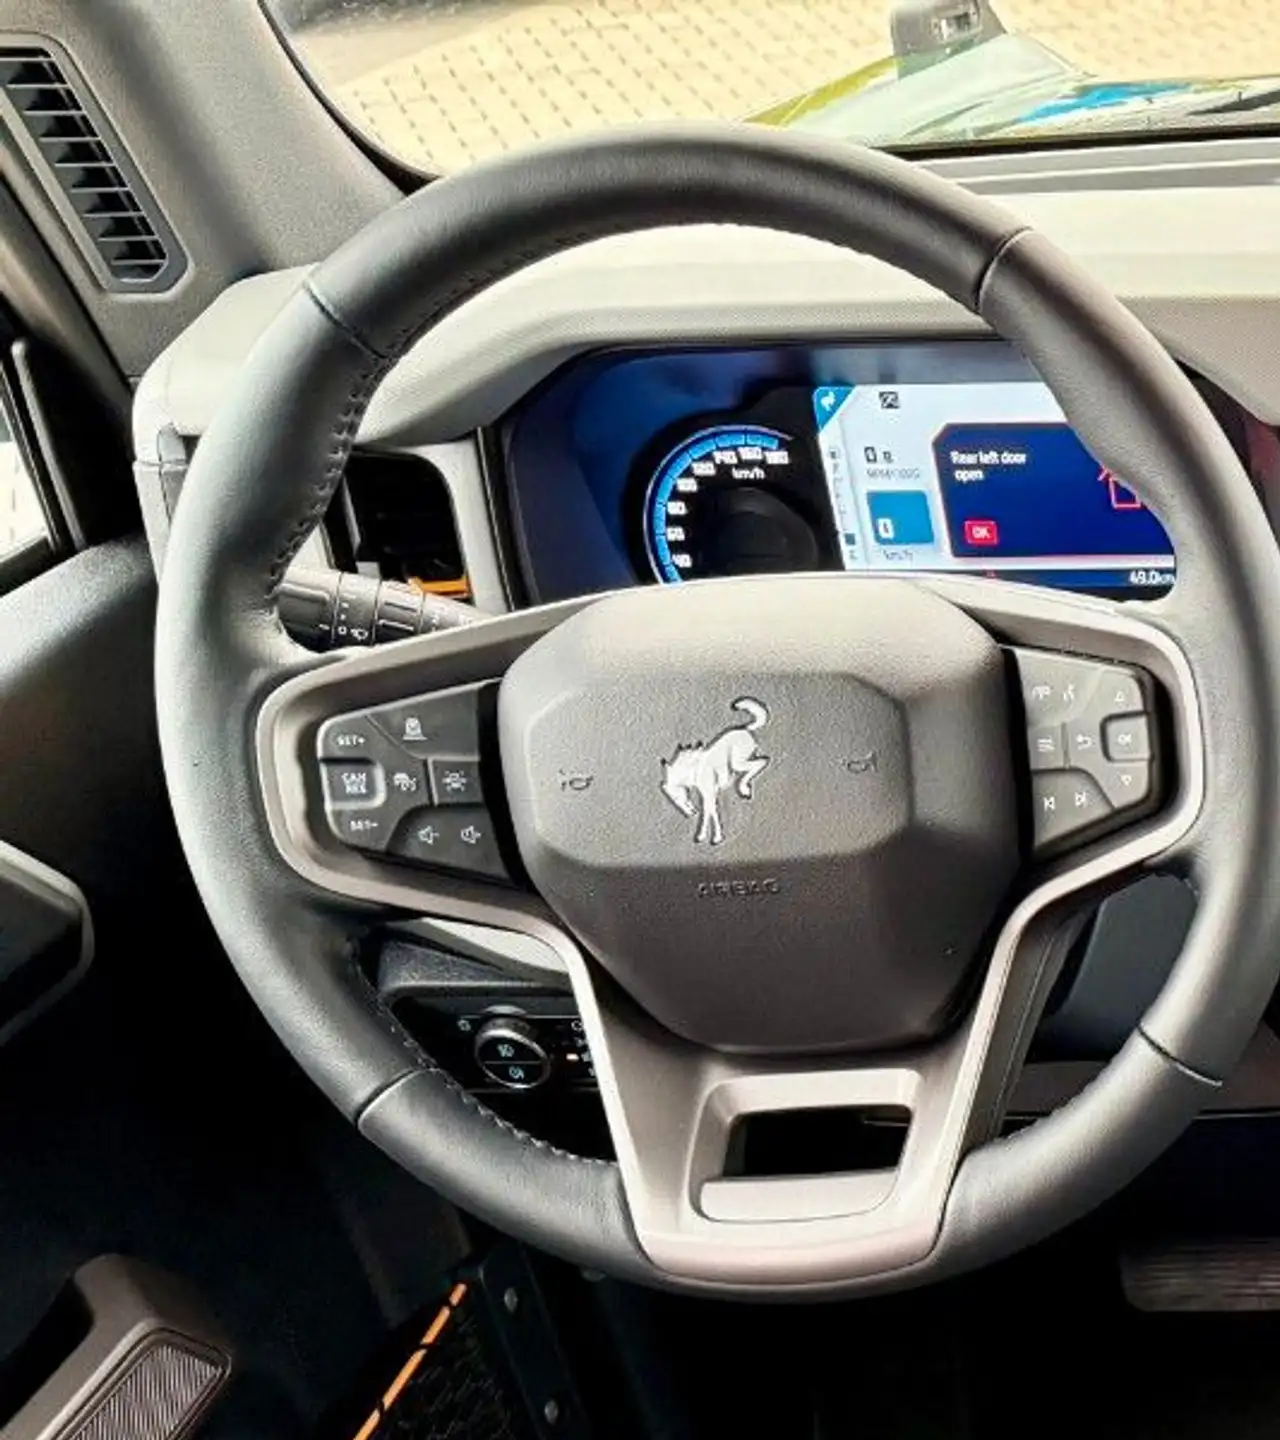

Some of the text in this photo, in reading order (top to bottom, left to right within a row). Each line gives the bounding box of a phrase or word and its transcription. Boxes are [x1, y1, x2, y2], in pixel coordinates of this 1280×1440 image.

[951, 451, 1026, 465] Rear left door
[732, 466, 765, 479] km/h
[955, 470, 983, 482] open
[971, 526, 991, 540] OK
[336, 734, 366, 746] SET+
